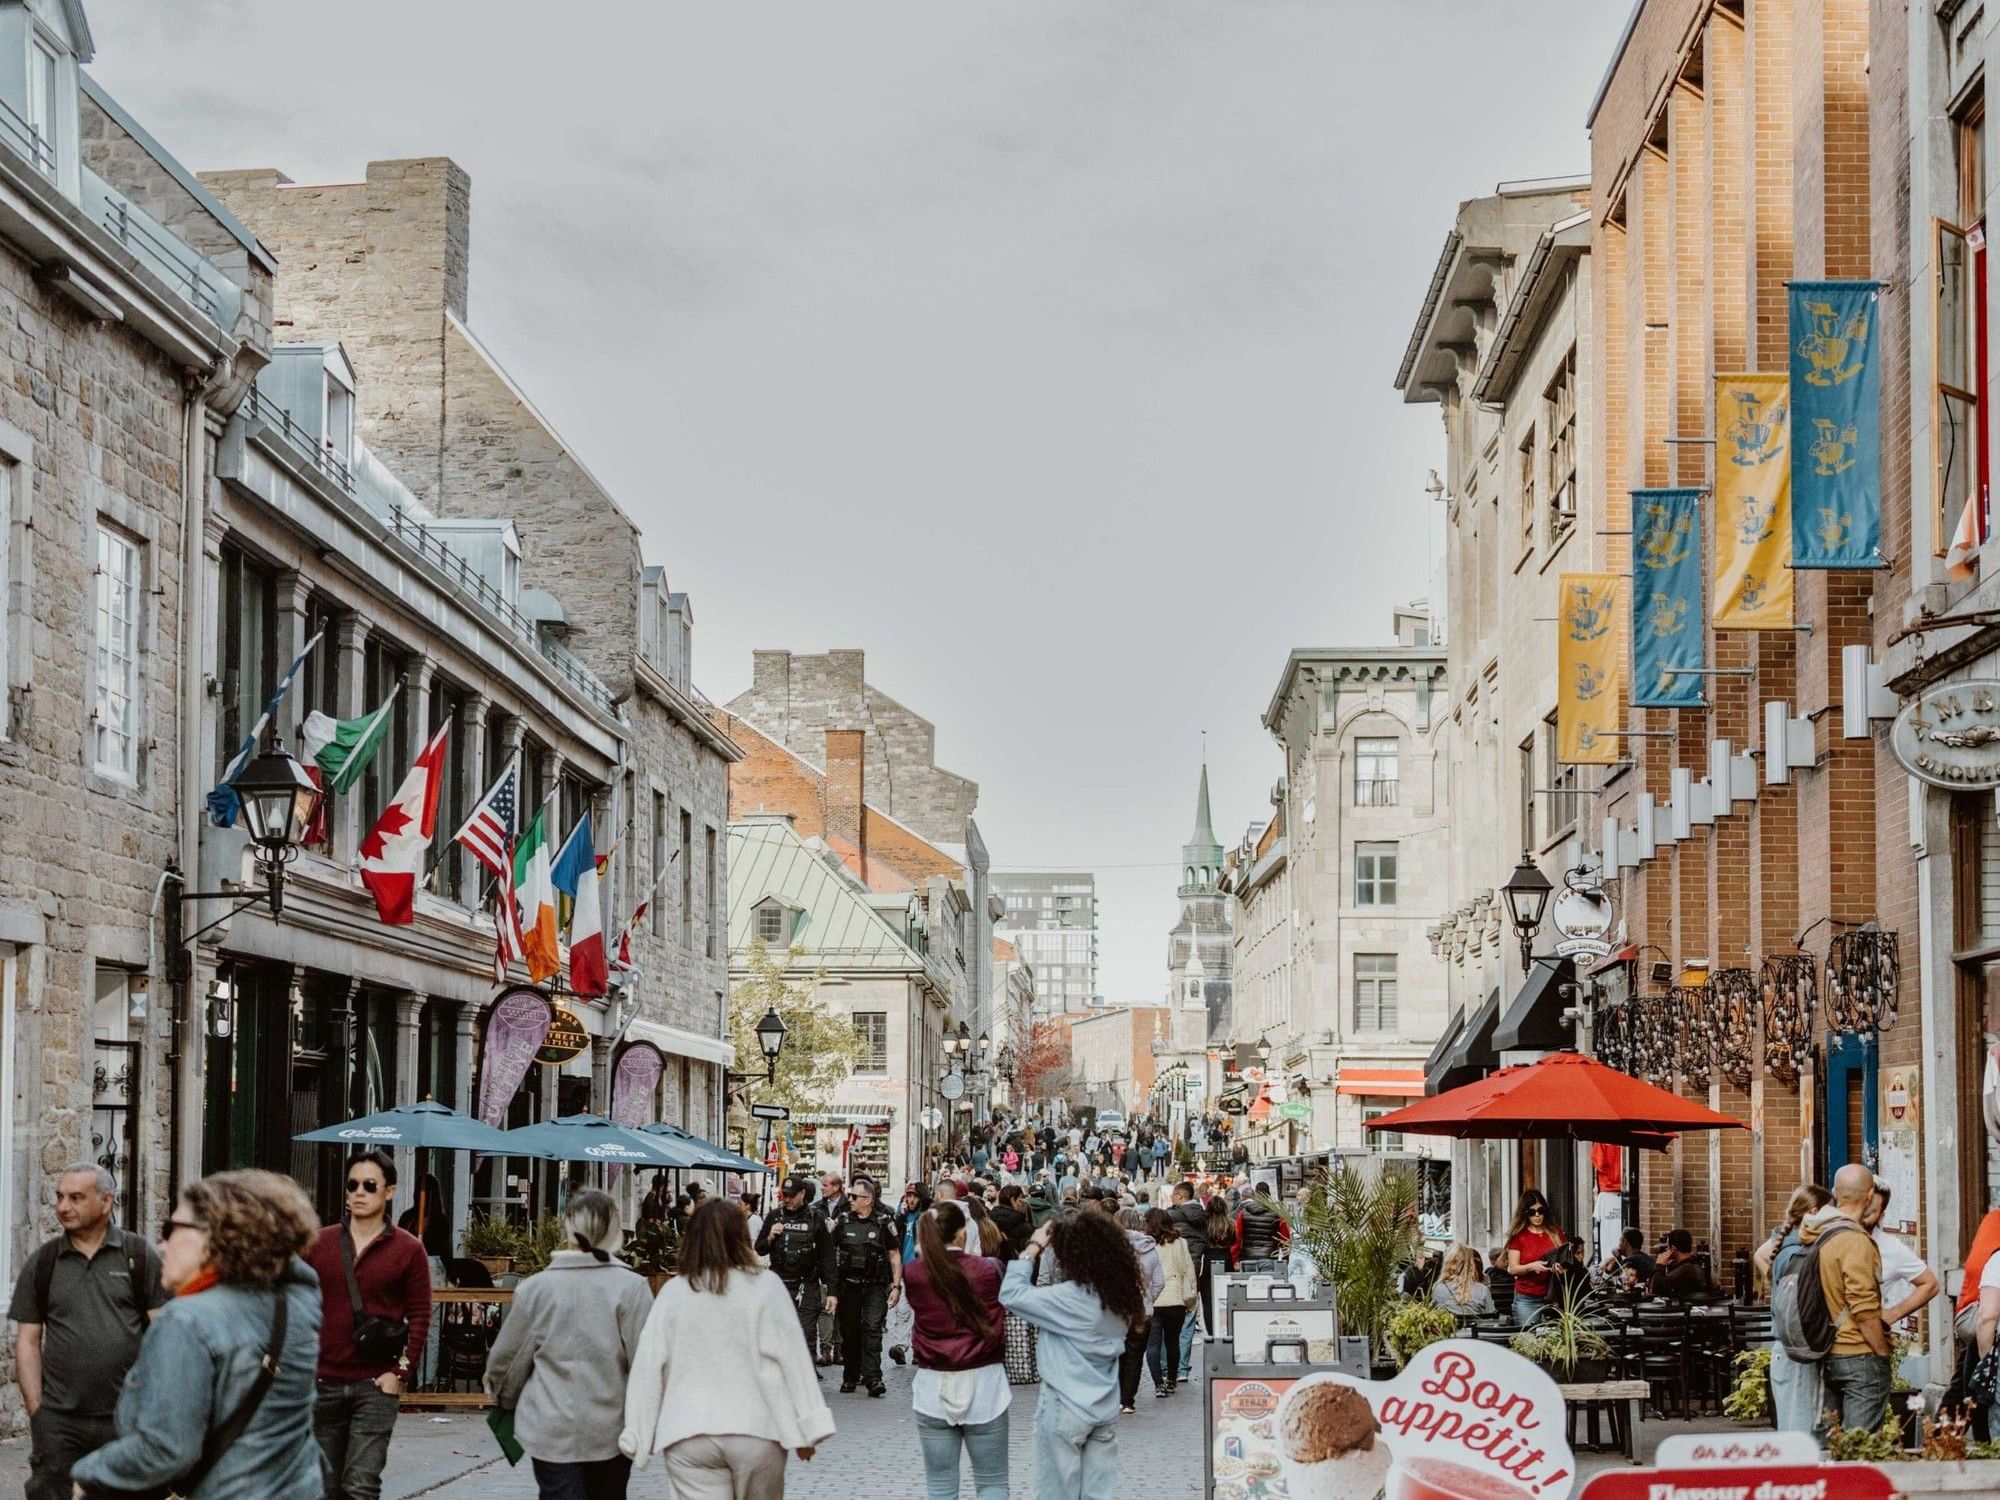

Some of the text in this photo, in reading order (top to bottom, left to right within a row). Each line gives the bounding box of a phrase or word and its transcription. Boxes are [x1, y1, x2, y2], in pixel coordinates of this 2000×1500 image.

[561, 1012, 579, 1027] BAR
[338, 1129, 402, 1140] Corona
[584, 1147, 648, 1158] Corona
[1422, 1351, 1540, 1430] Bon
[1380, 1396, 1568, 1494] appétit!
[1648, 1478, 1826, 1500] Flavour drop!
